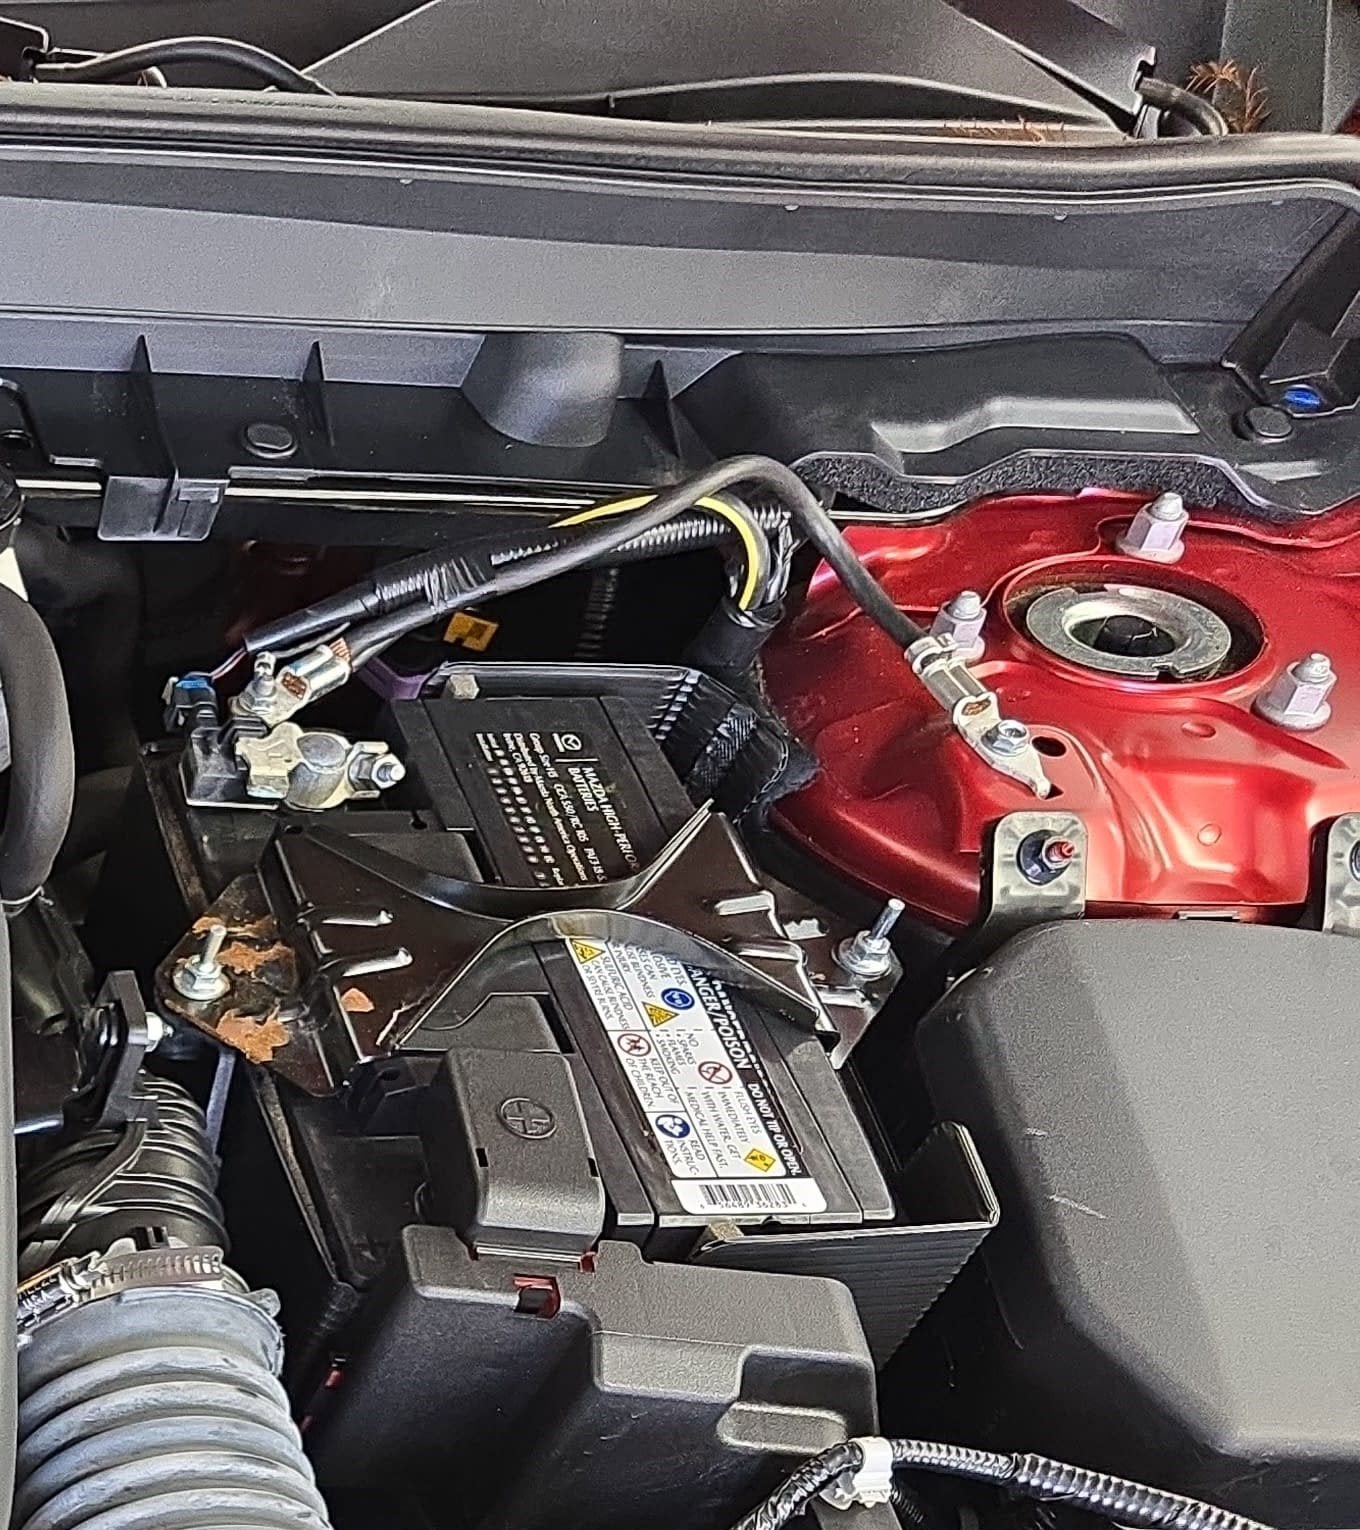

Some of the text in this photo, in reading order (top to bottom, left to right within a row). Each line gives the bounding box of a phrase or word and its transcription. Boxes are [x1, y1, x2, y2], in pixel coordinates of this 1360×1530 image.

[568, 767, 599, 811] BATTERIES
[582, 768, 608, 802] MAZDA
[655, 1039, 681, 1075] SMOKING
[666, 1039, 687, 1065] FLAMES
[676, 1039, 697, 1064] SPARKS
[685, 1033, 700, 1047] NO
[625, 1058, 636, 1068] OF
[637, 1058, 663, 1097] THE REACH
[650, 1058, 679, 1104] KEEP OUT OF
[685, 1091, 709, 1127] MEDICAL
[701, 1128, 719, 1147] HELP
[701, 1091, 719, 1112] WITH
[726, 1144, 741, 1159] GET
[718, 1091, 750, 1143] IMMEDIATELY
[733, 1091, 762, 1134] FLUSH EYES
[748, 1084, 762, 1098] DO
[755, 1097, 774, 1119] NOT
[767, 1117, 781, 1135] TIP
[774, 1134, 788, 1151] OR
[690, 1140, 706, 1160] READ
